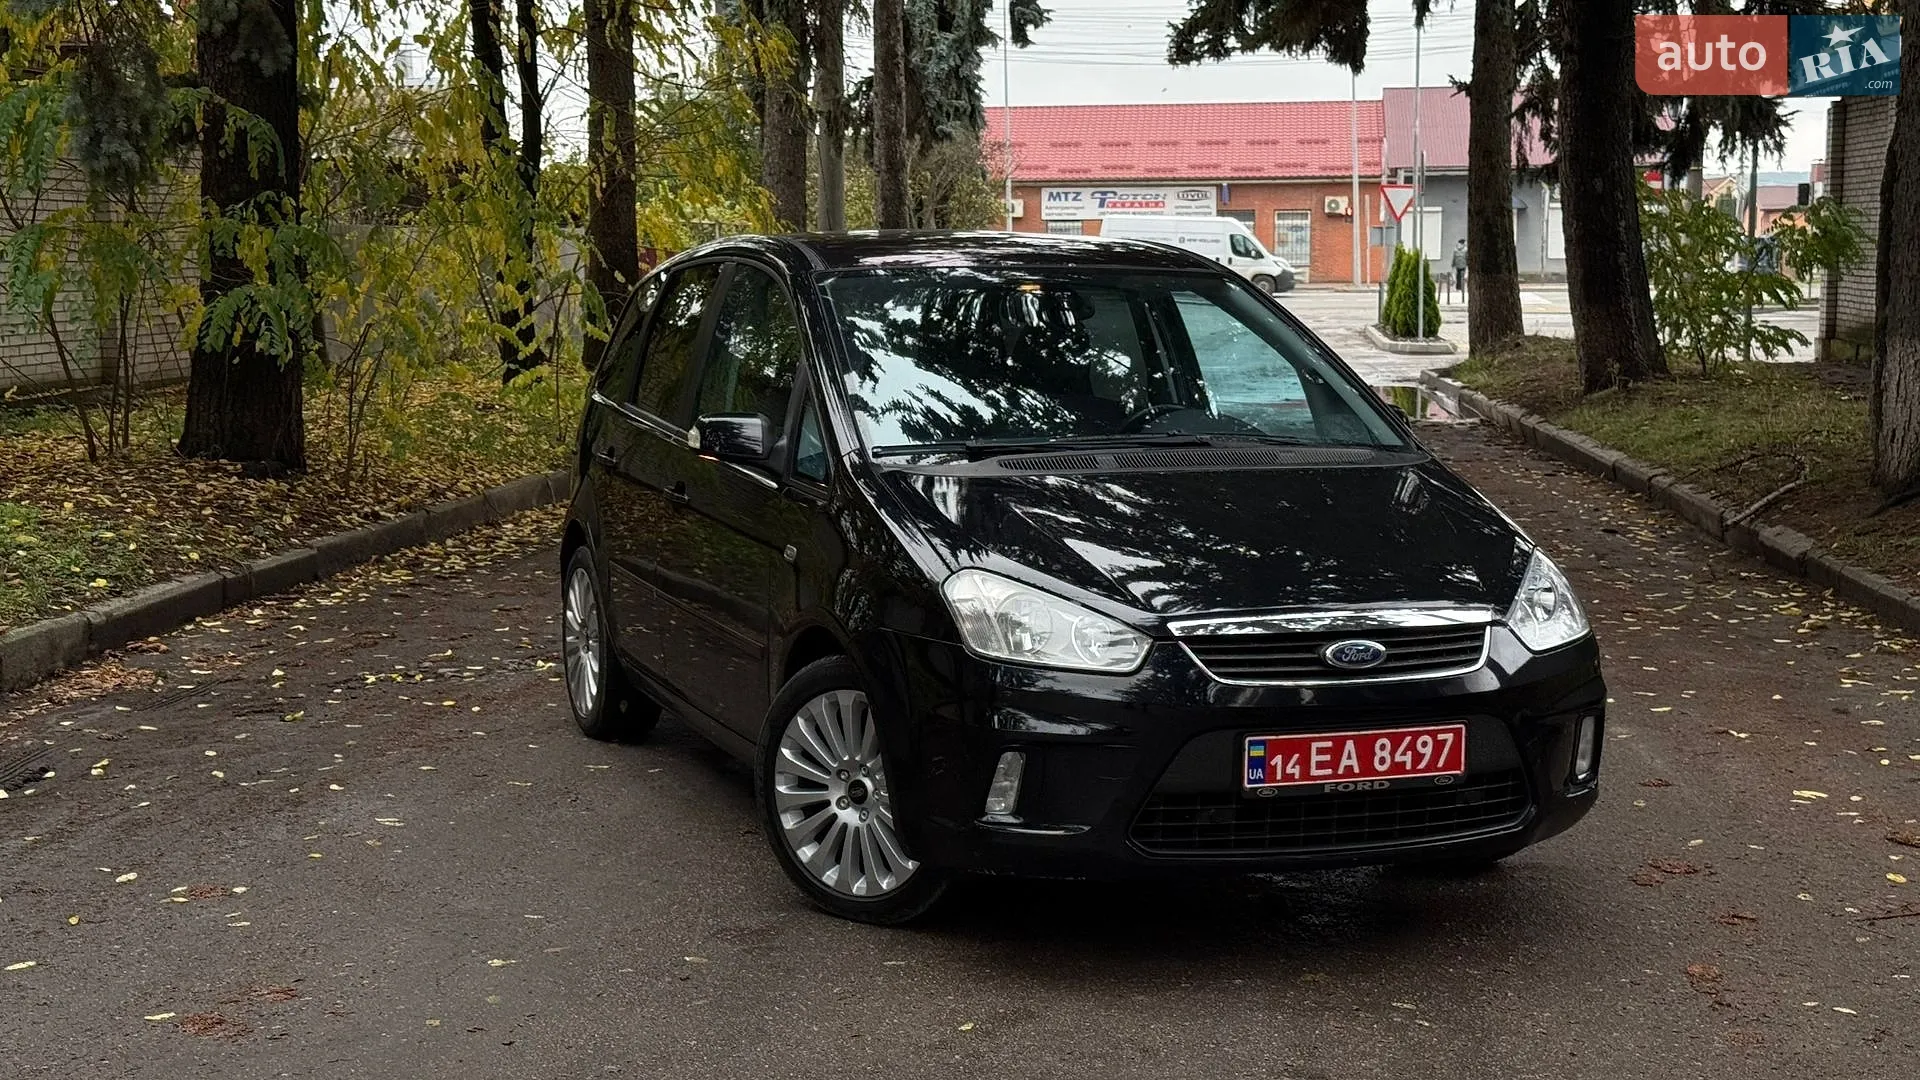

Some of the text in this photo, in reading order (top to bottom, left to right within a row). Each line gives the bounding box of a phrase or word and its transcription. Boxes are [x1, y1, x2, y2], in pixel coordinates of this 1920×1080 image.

[1048, 191, 1082, 202] MTZ
[1342, 645, 1375, 661] Ford
[1270, 733, 1454, 780] 14 EA 8497
[1249, 768, 1264, 780] UA
[1324, 780, 1391, 792] FORD
